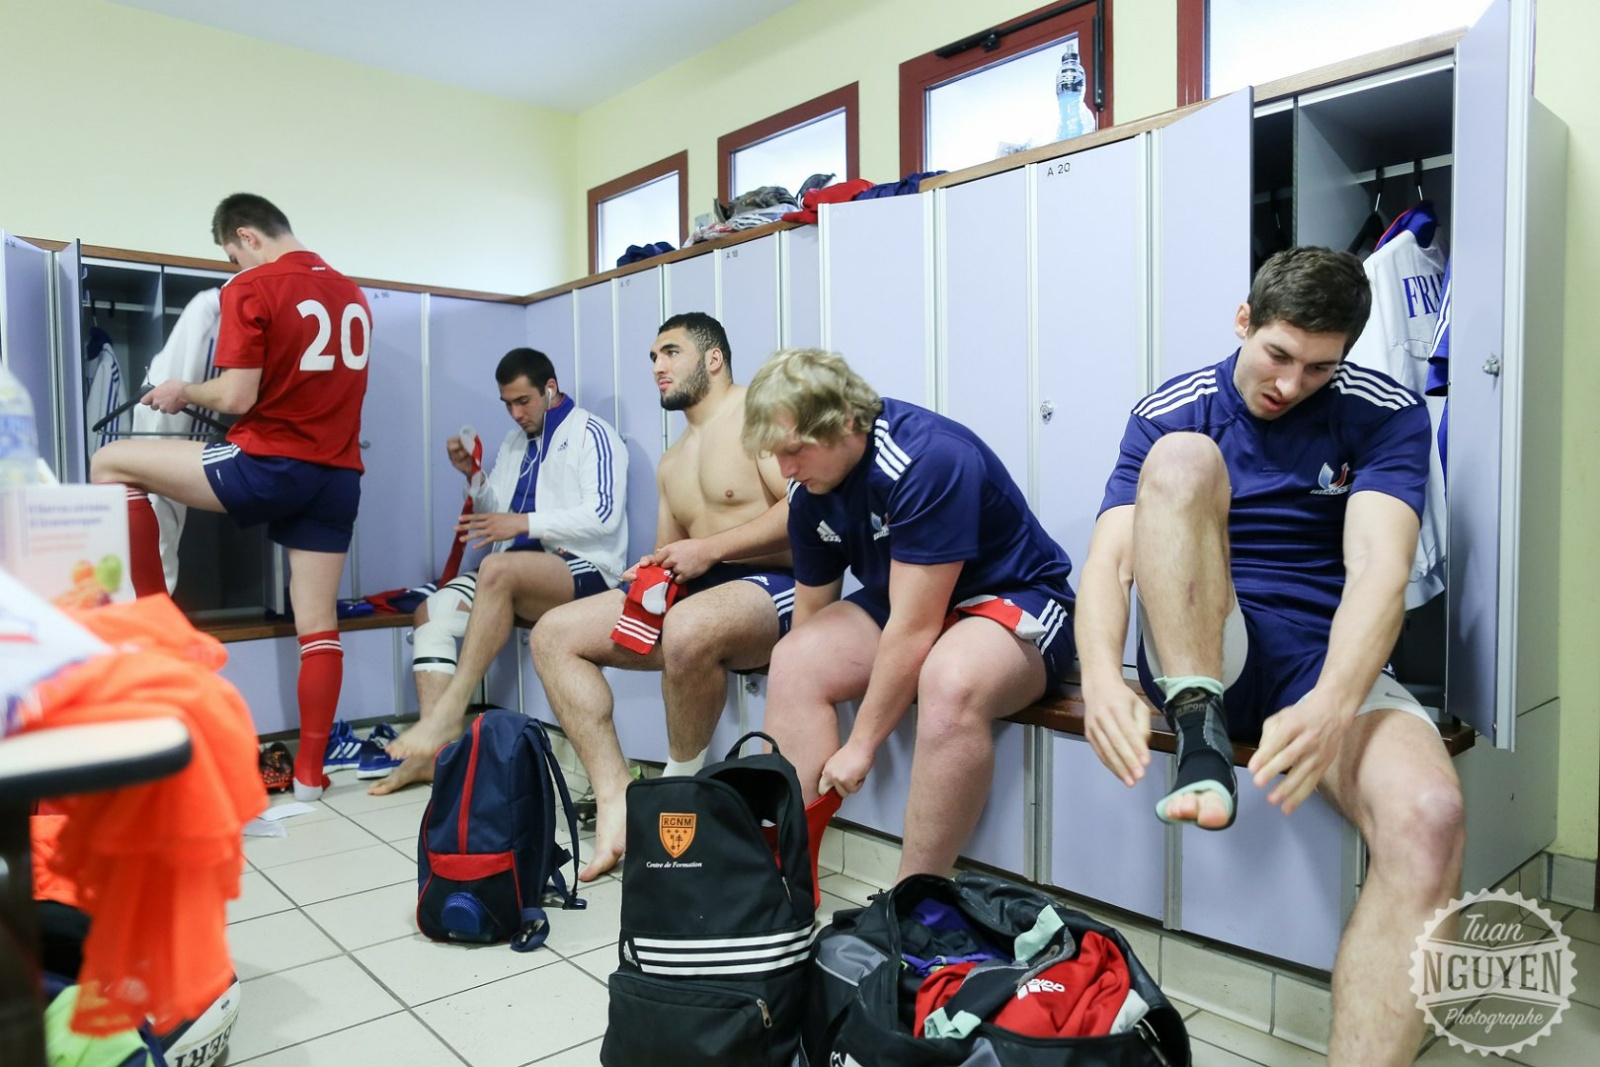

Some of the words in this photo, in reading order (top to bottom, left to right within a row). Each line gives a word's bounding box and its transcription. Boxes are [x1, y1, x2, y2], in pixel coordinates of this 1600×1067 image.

[1047, 167, 1054, 177] A
[1057, 162, 1071, 174] 20
[296, 298, 371, 372] 20
[664, 817, 692, 826] RCNM
[672, 860, 702, 868] Formation
[174, 1021, 233, 1067] BERT
